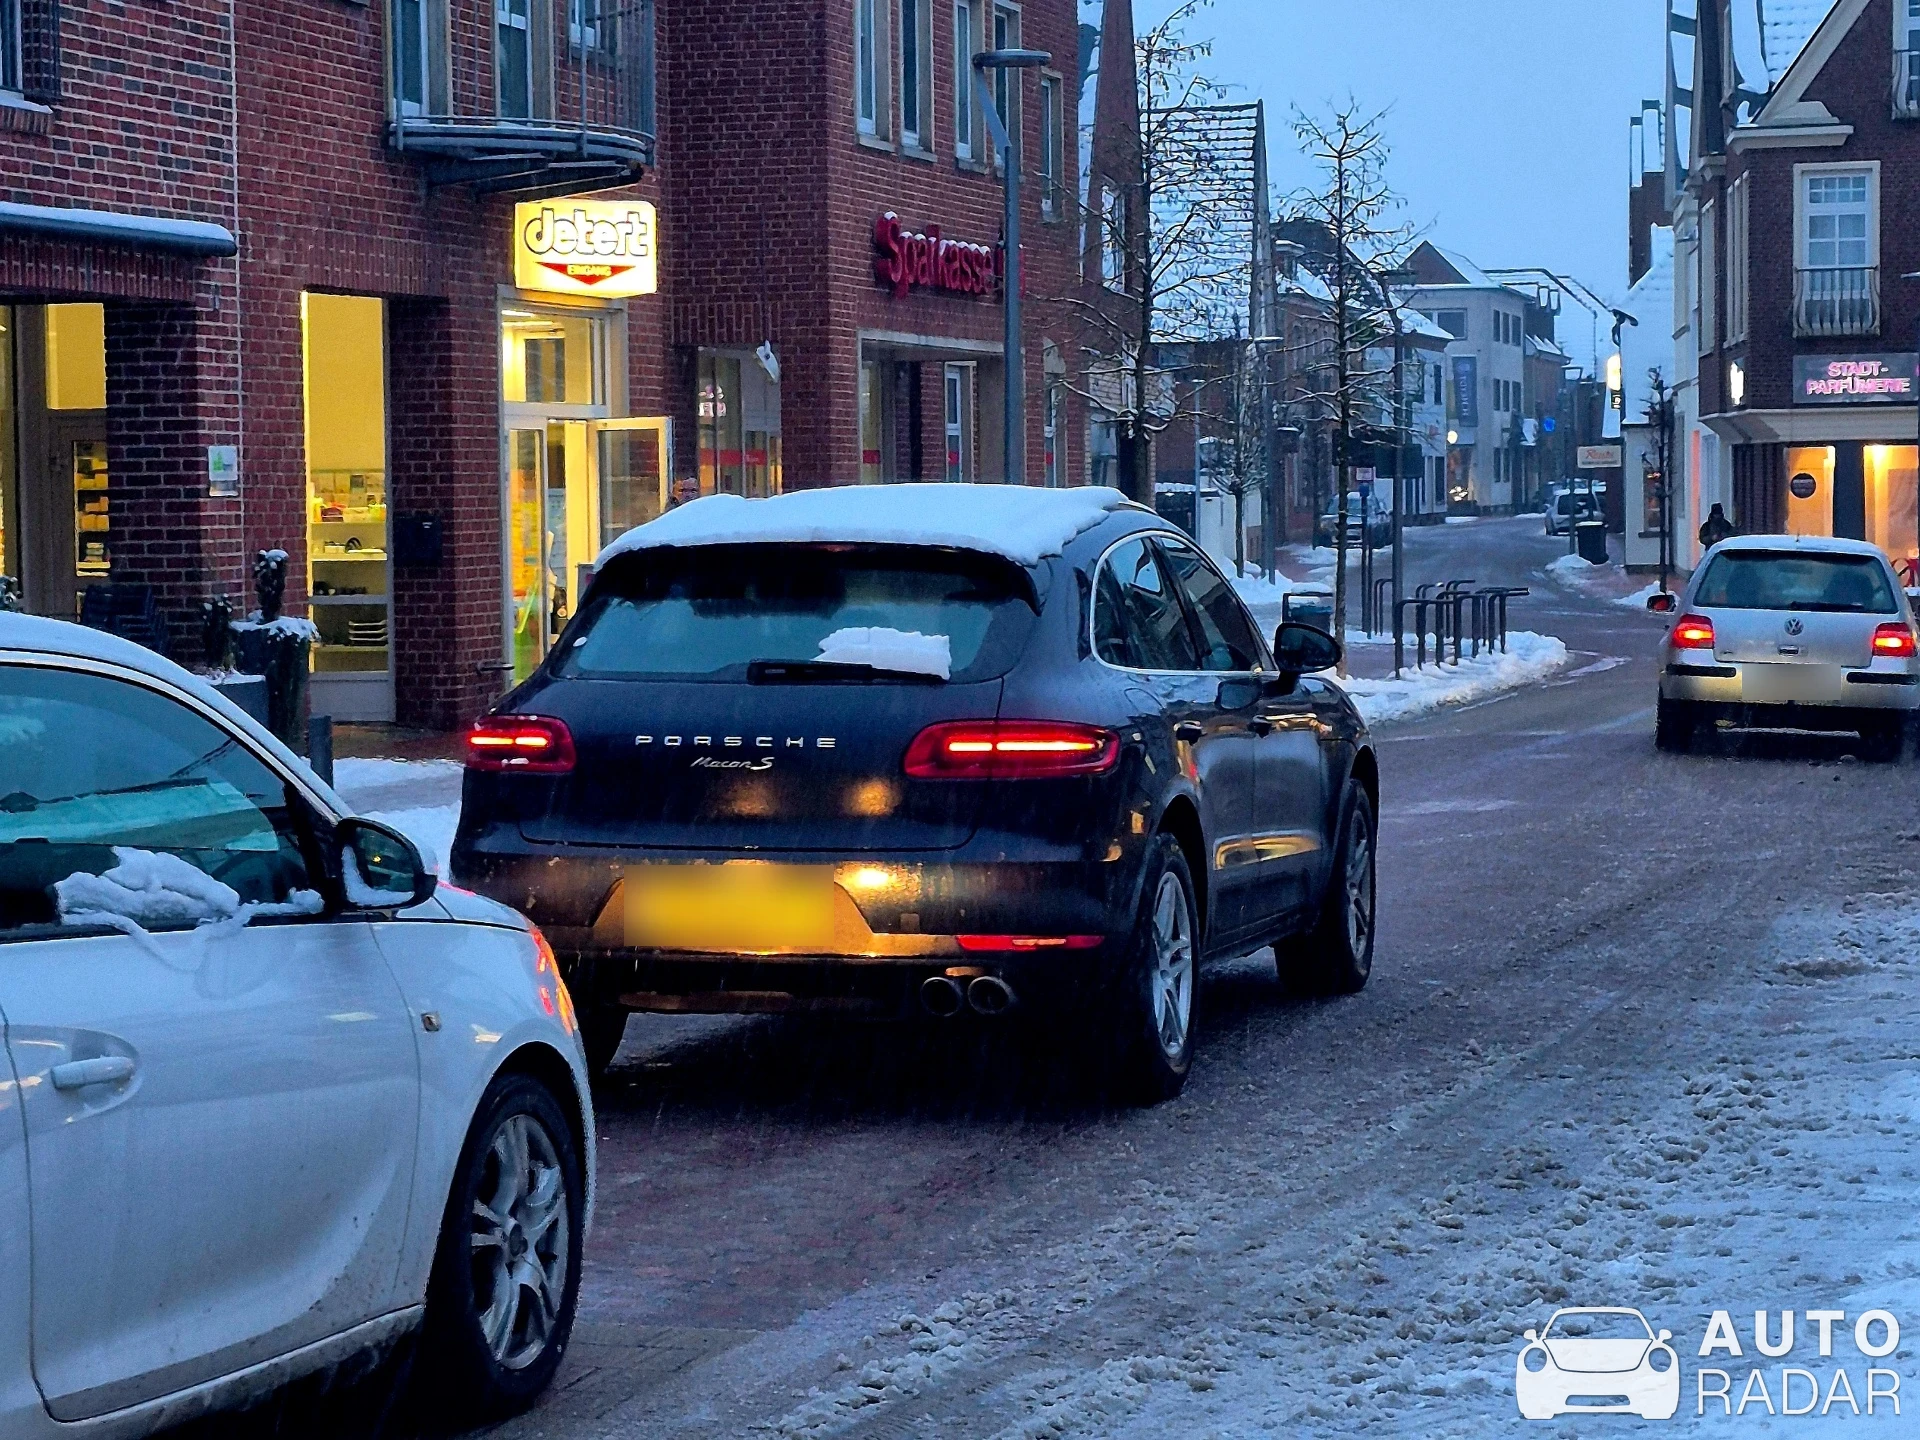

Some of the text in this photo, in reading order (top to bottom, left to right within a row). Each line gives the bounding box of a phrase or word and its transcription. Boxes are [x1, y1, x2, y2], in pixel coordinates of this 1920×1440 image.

[524, 207, 648, 256] detert
[876, 211, 995, 299] Sparkasse
[1828, 361, 1889, 377] STADT-
[1806, 376, 1911, 395] PARFÜMERIE
[635, 735, 836, 748] PORSCHE
[690, 757, 775, 771] Macan S
